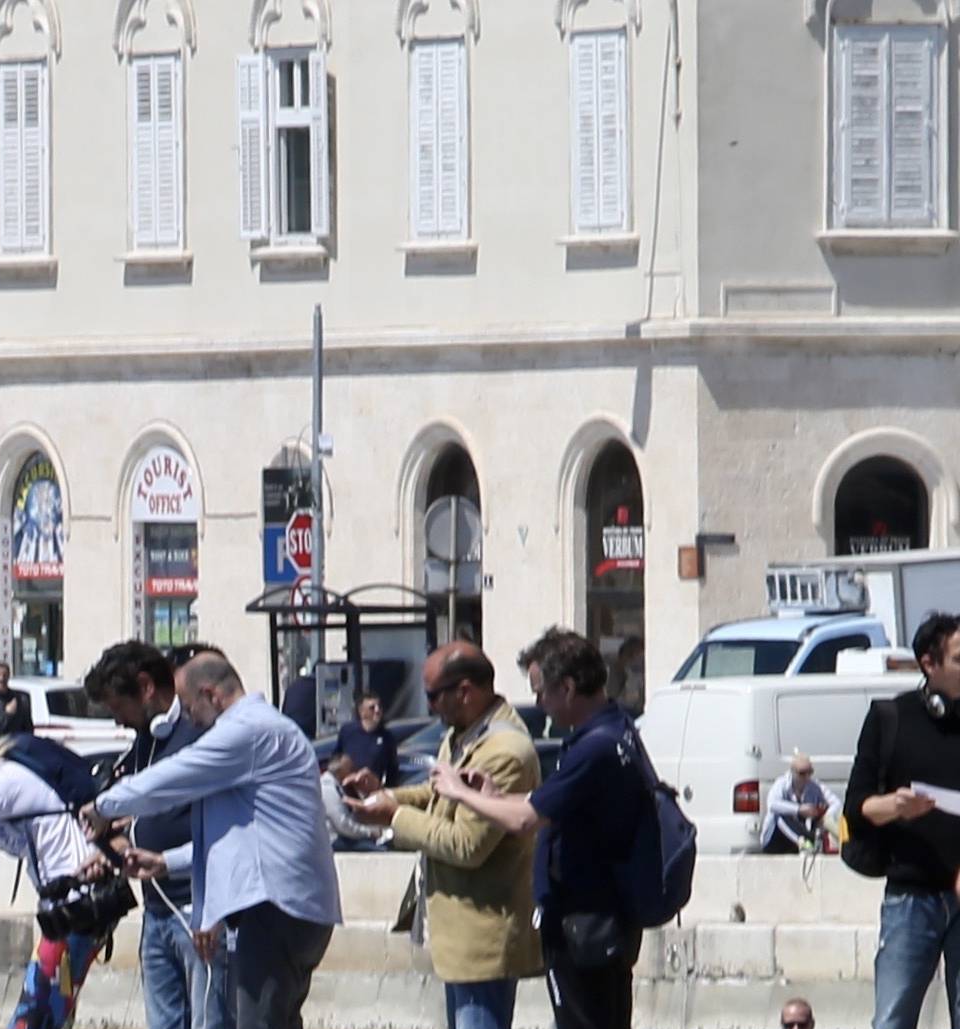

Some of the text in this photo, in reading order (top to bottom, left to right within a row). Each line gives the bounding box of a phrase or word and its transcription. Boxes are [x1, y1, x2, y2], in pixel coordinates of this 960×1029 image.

[137, 455, 192, 500] TOURIST
[149, 494, 182, 515] OFFICE
[290, 528, 312, 555] STO
[602, 535, 643, 558] VERBUM
